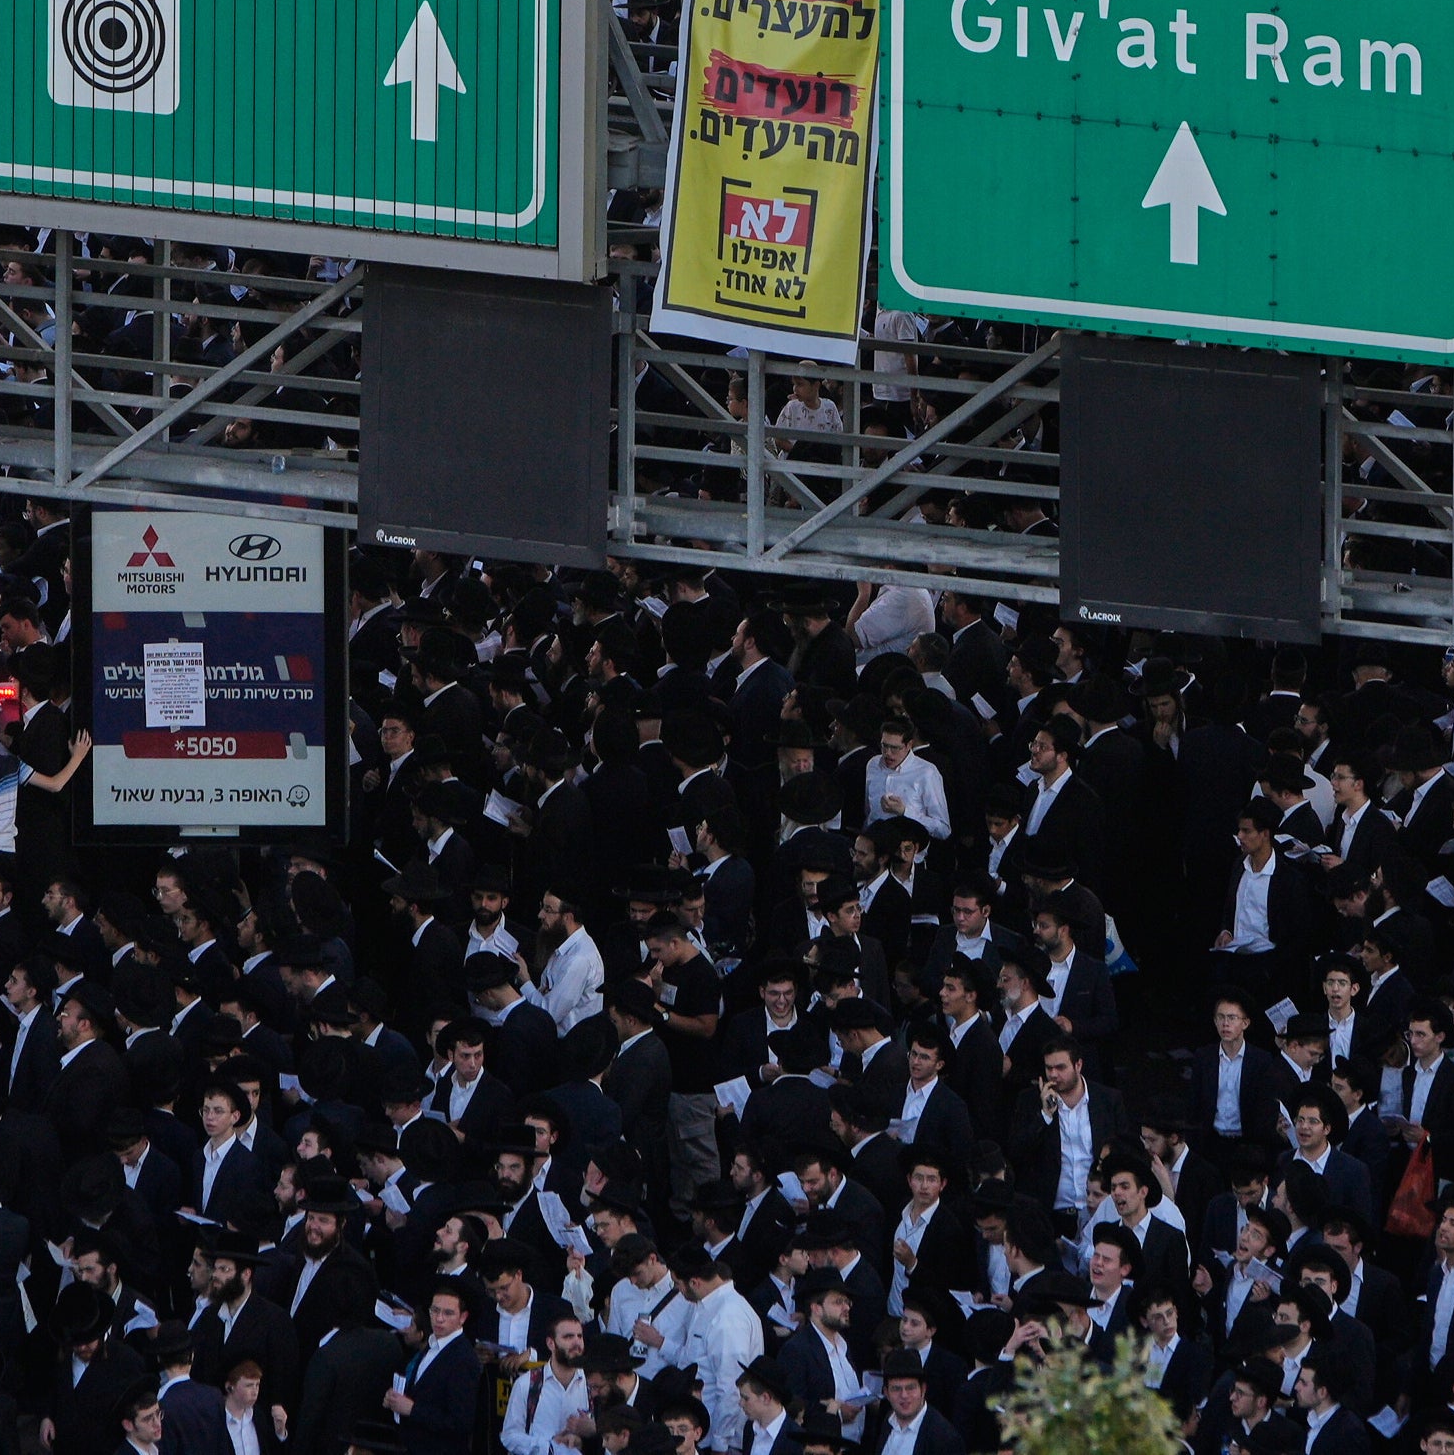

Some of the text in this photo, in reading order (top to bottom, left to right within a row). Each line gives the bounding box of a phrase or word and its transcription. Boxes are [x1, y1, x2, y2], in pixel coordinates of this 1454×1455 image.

[1245, 12, 1423, 96] Ram
[729, 198, 800, 243] לא,
[732, 240, 797, 272] אפילו
[716, 268, 806, 301] לא אחד.
[385, 535, 416, 546] LACROIX
[117, 572, 185, 583] MITSUBISHI
[205, 566, 307, 583] HYUNDAI
[127, 584, 176, 595] MOTORS
[1088, 612, 1121, 623] LACROIX
[205, 661, 265, 681] גולדמו
[205, 688, 241, 699] מורש
[243, 688, 280, 700] שירות
[282, 687, 314, 701] מרכז
[110, 784, 155, 803] שאול
[159, 788, 205, 805] גבעת
[229, 788, 283, 804] האופה
